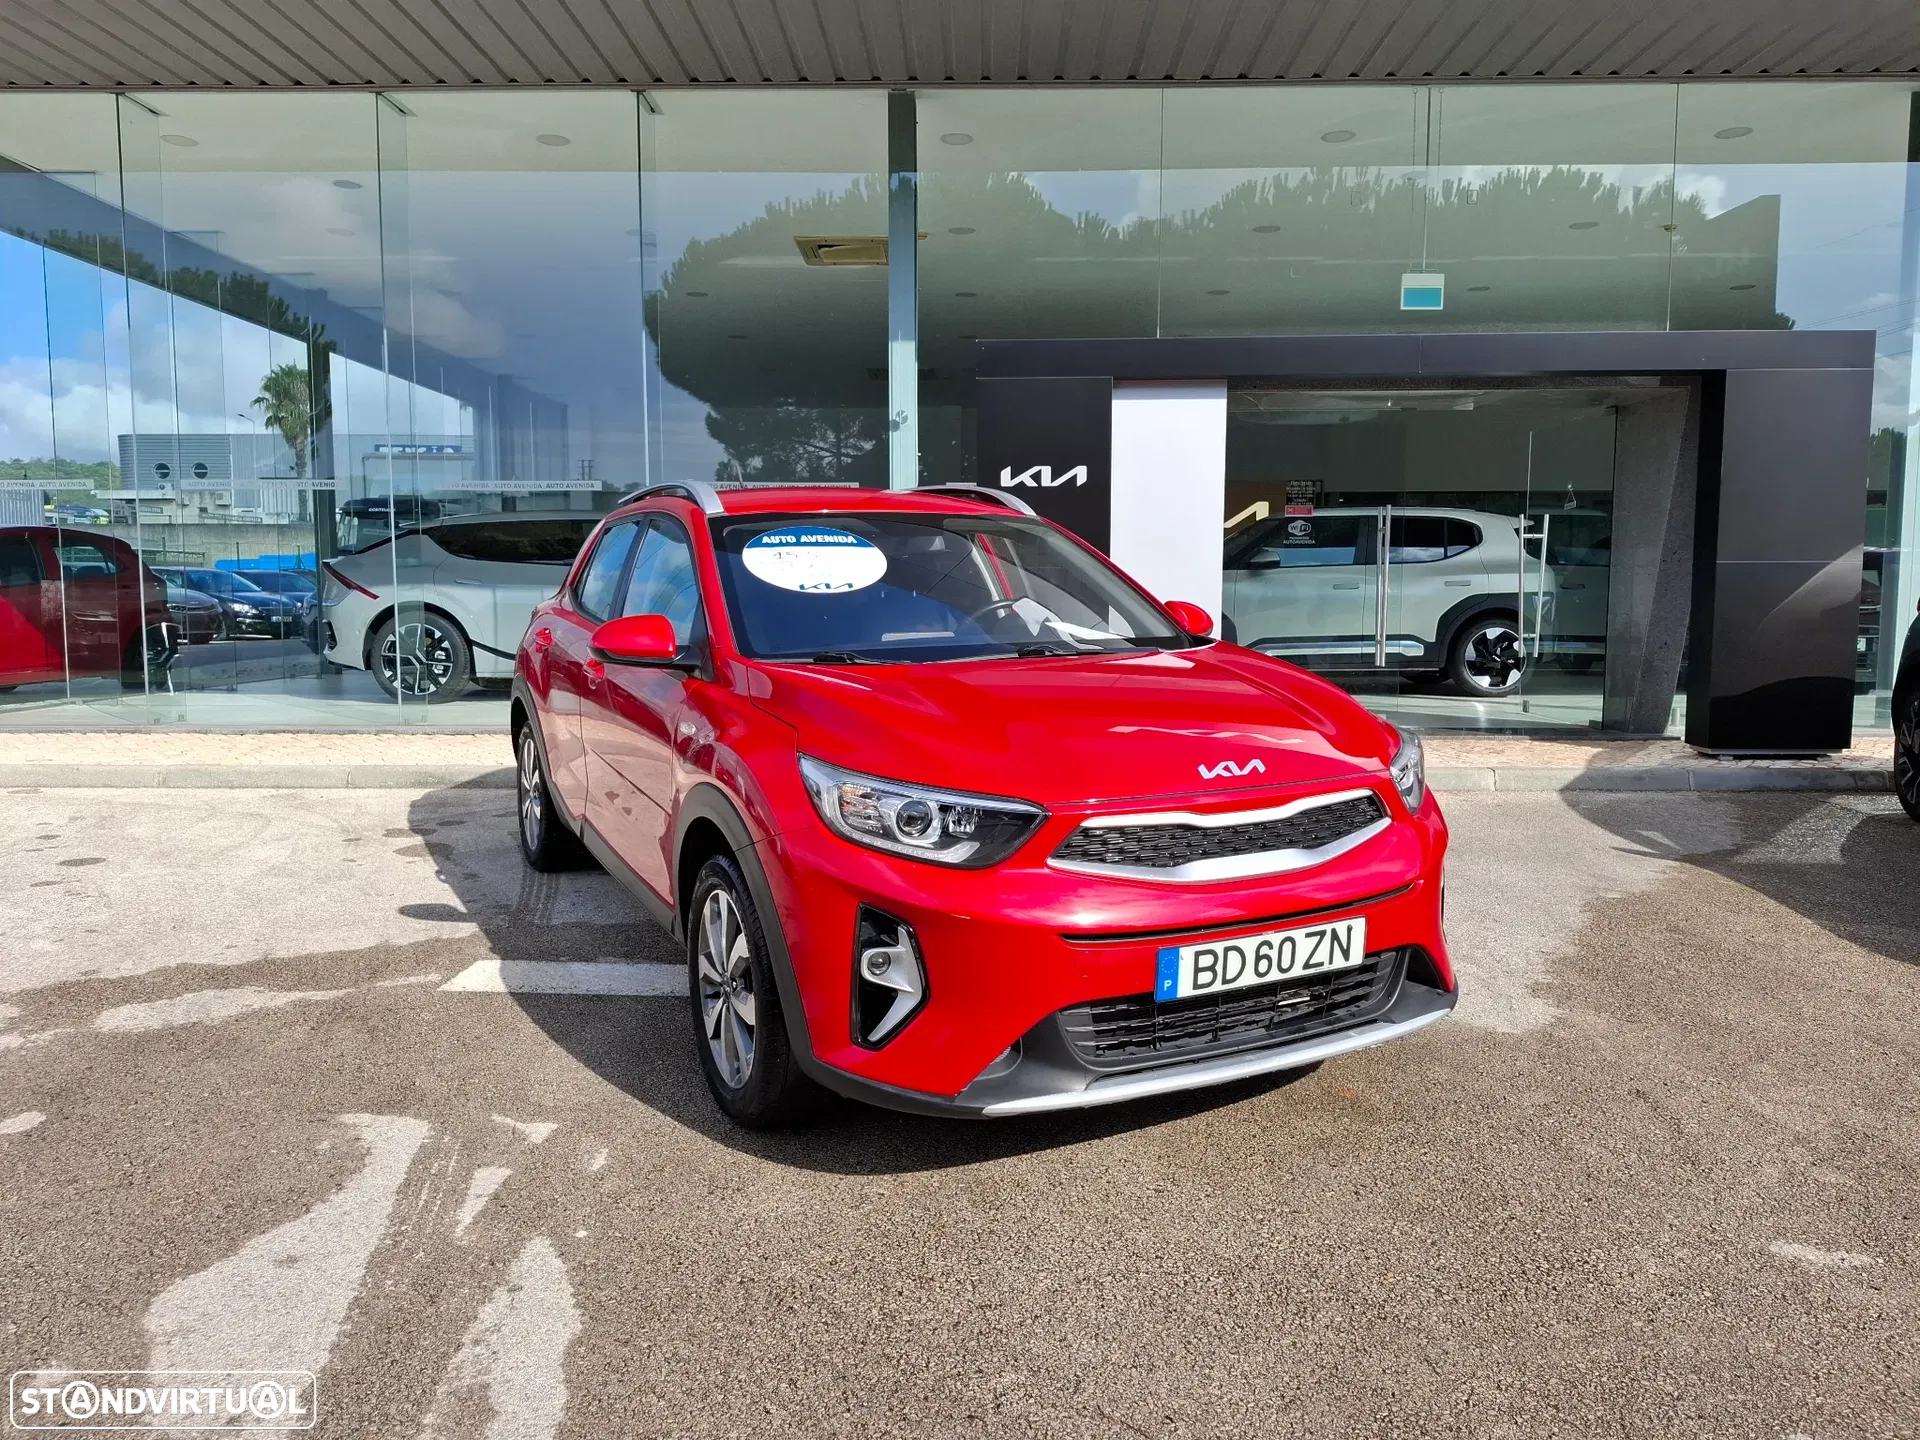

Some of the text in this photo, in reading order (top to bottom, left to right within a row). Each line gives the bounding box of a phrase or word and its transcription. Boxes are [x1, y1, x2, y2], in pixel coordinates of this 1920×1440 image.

[1001, 465, 1087, 487] KIA
[762, 535, 857, 544] AUTO AVENIDA
[799, 582, 854, 590] KIA
[1198, 759, 1266, 779] KIA
[1192, 924, 1353, 991] BD 60 ZN
[1164, 980, 1172, 992] P
